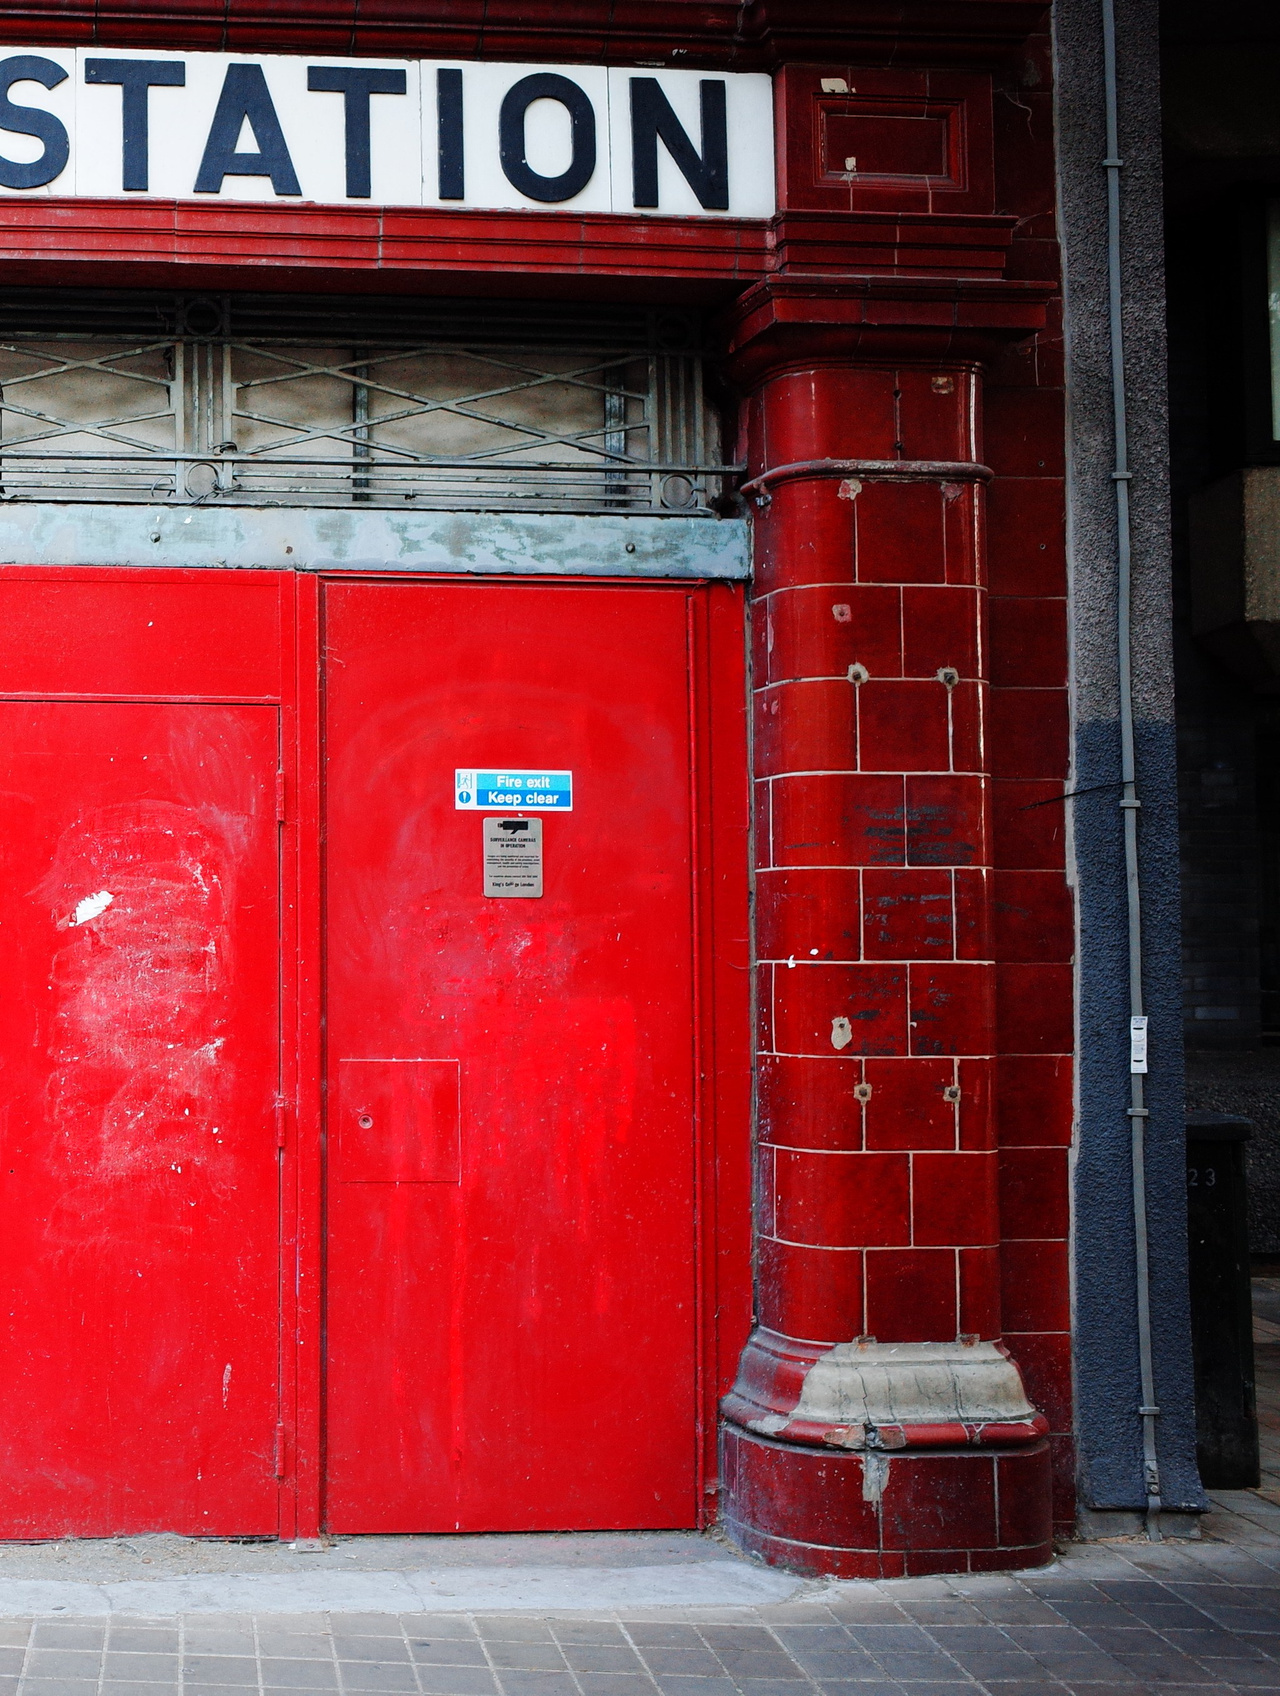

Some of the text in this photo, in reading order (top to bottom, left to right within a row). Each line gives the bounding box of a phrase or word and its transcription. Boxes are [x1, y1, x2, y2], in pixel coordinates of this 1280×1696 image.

[497, 775, 550, 788] Fire exit
[488, 791, 559, 807] Keep clear
